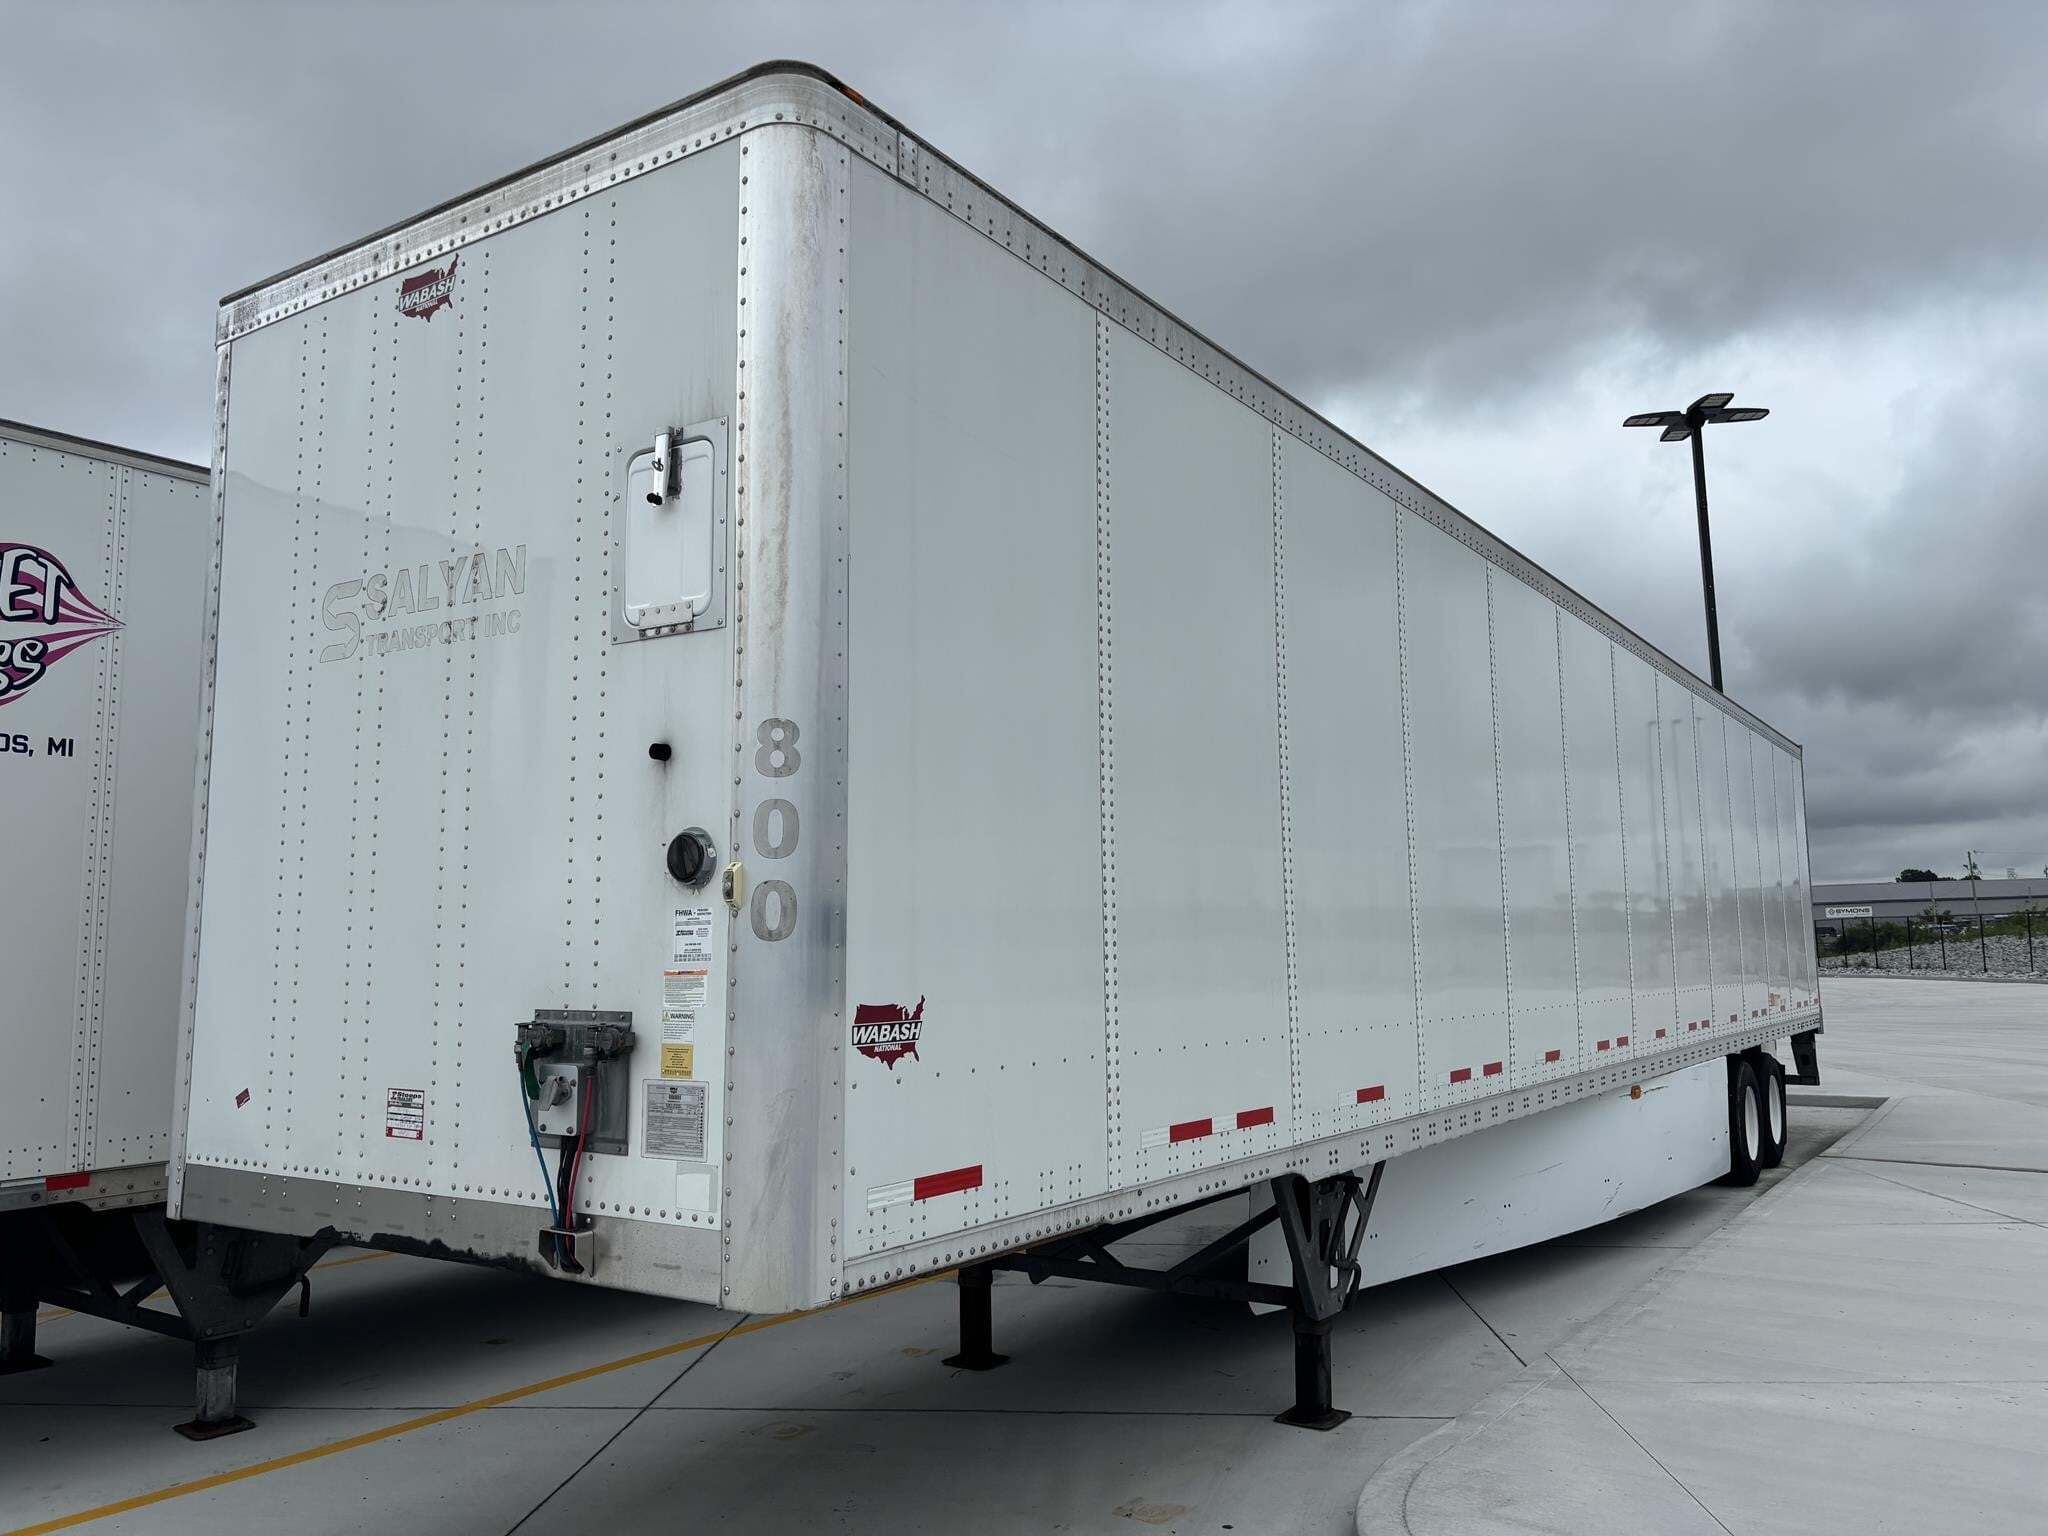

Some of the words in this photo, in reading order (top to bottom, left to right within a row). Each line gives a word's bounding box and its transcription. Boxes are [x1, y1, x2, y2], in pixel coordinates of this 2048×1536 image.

[400, 275, 455, 312] WABASH
[0, 548, 74, 625] ET
[365, 544, 527, 621] SALYAN
[366, 615, 478, 656] TRANSPORT
[484, 609, 522, 638] INC
[48, 736, 75, 757] MI
[852, 1022, 922, 1045] WABASH
